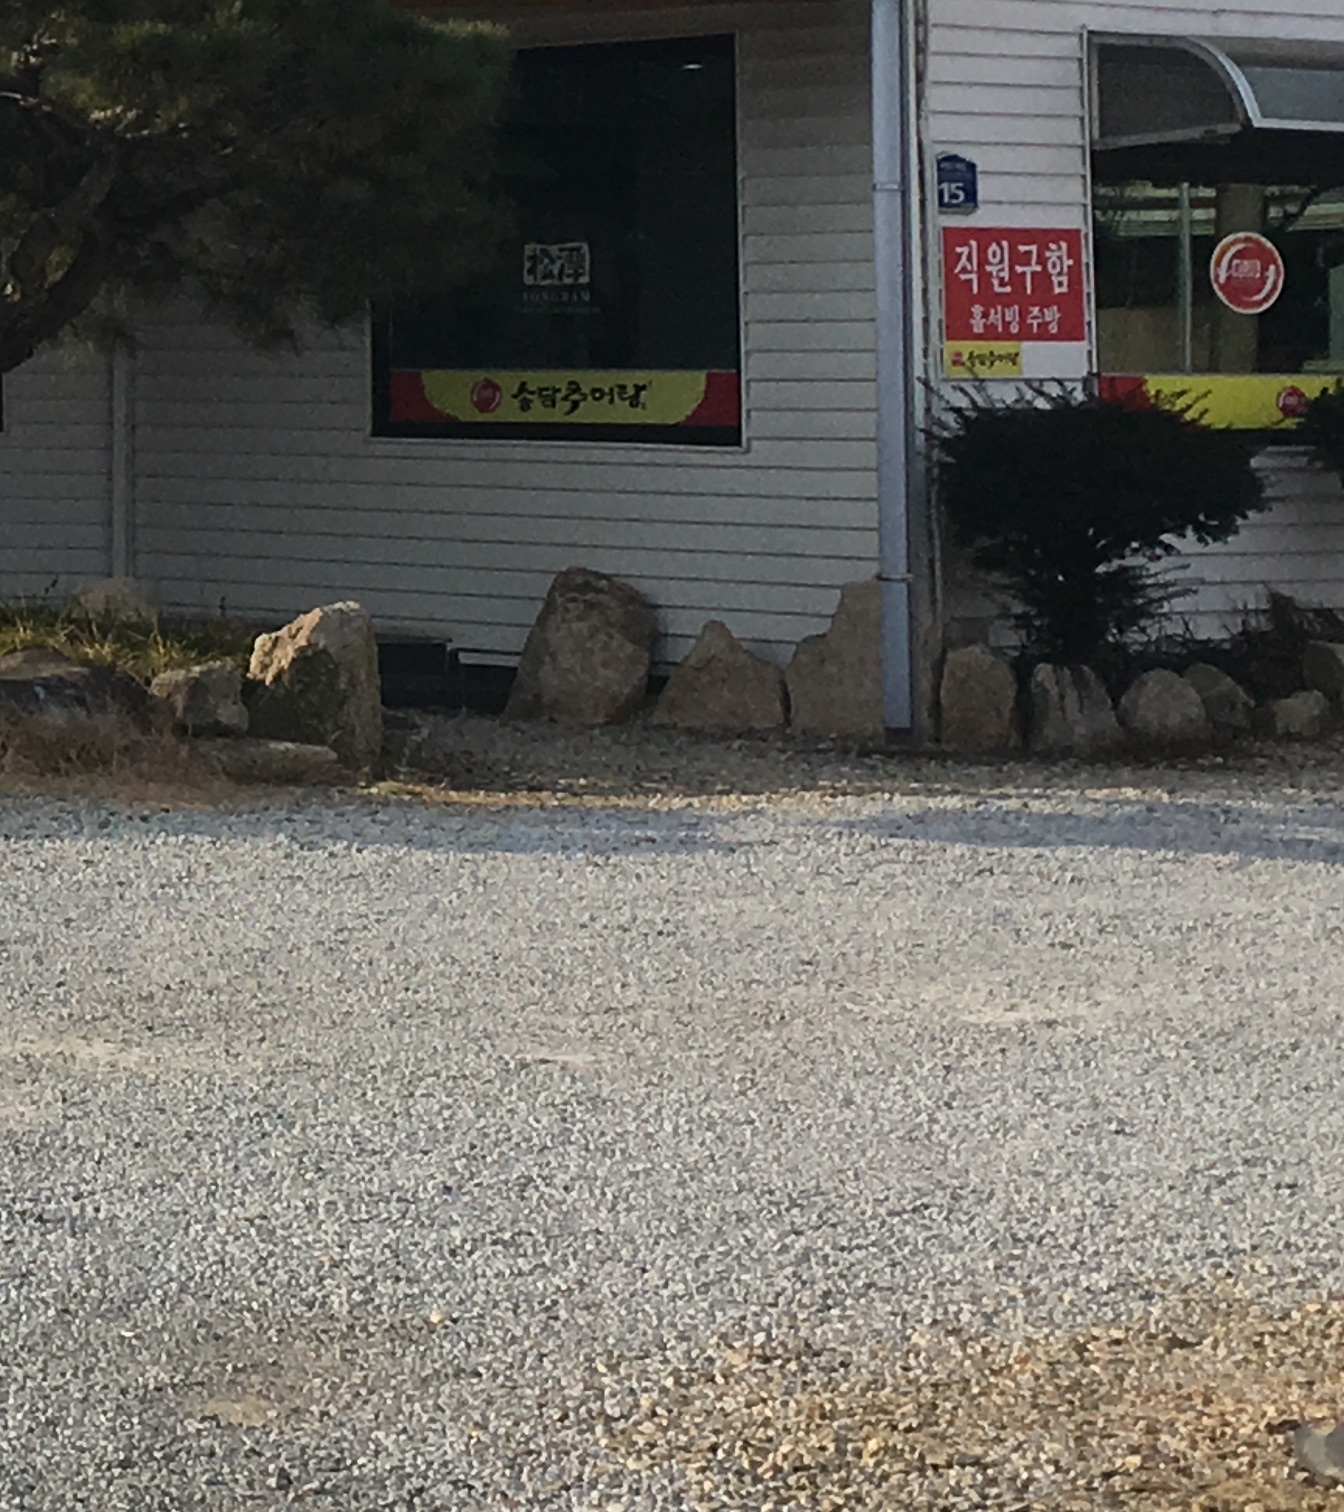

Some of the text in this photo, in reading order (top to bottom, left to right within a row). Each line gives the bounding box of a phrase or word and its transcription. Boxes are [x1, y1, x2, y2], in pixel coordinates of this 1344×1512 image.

[939, 181, 966, 204] 15
[953, 239, 1074, 295] 직원구함
[969, 304, 1063, 334] 홀서빙 주방
[511, 380, 646, 416] 송담추어탕
